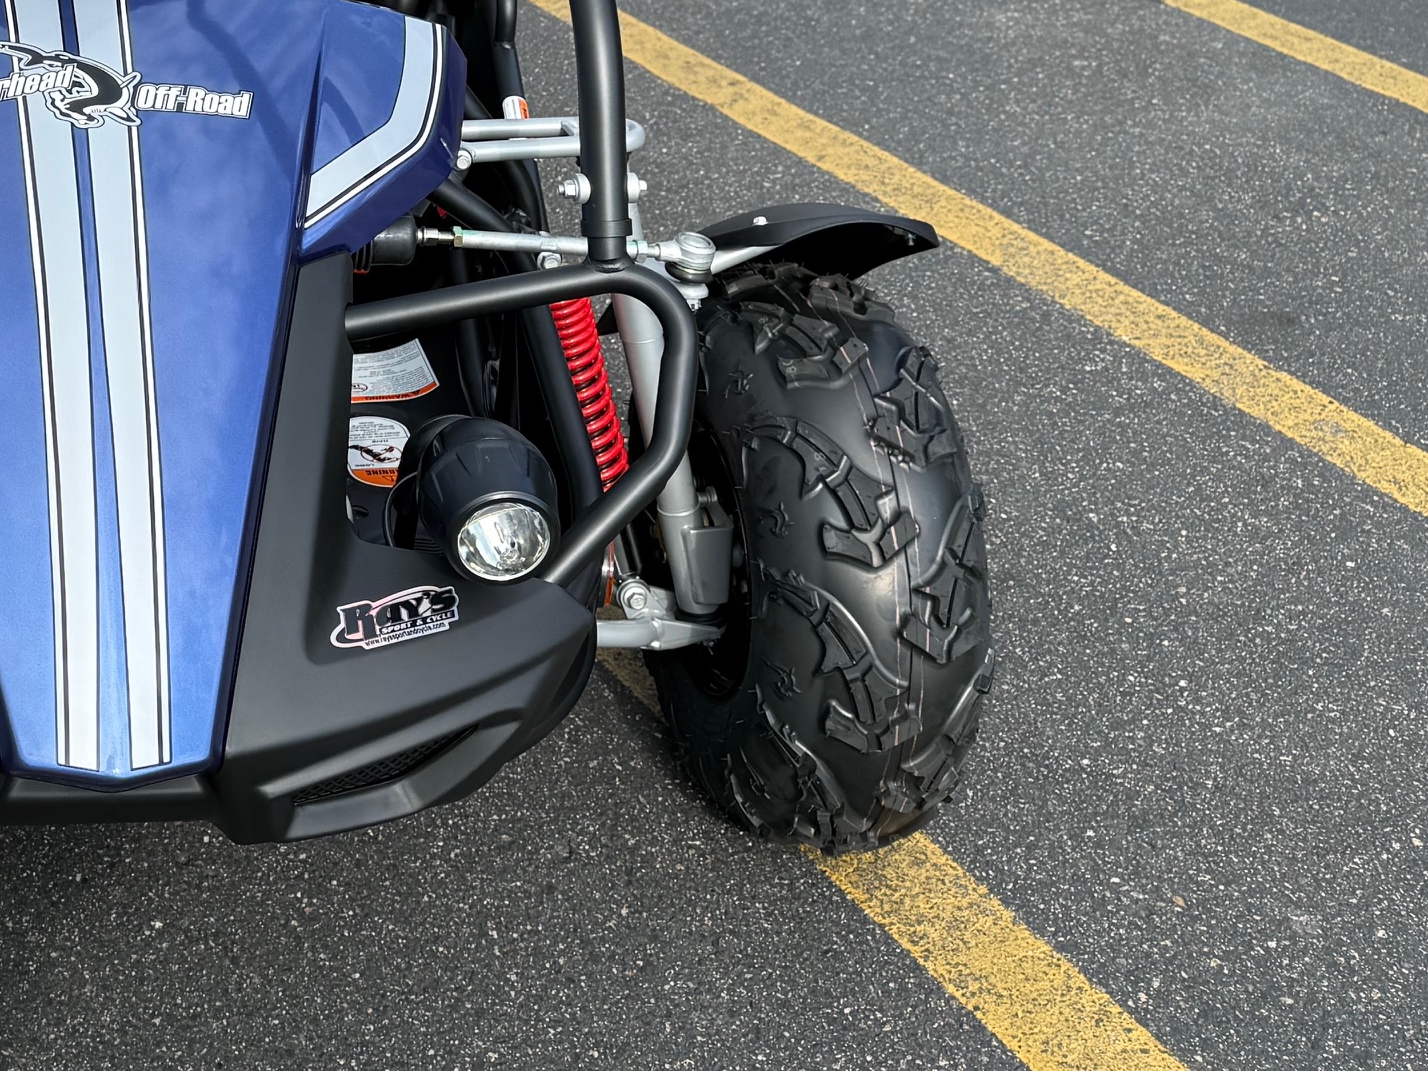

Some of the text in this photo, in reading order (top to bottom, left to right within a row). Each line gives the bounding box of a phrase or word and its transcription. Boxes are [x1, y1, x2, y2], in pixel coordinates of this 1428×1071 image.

[136, 85, 253, 118] Off-Road
[381, 622, 413, 635] SPORT
[427, 610, 452, 623] CYCLE
